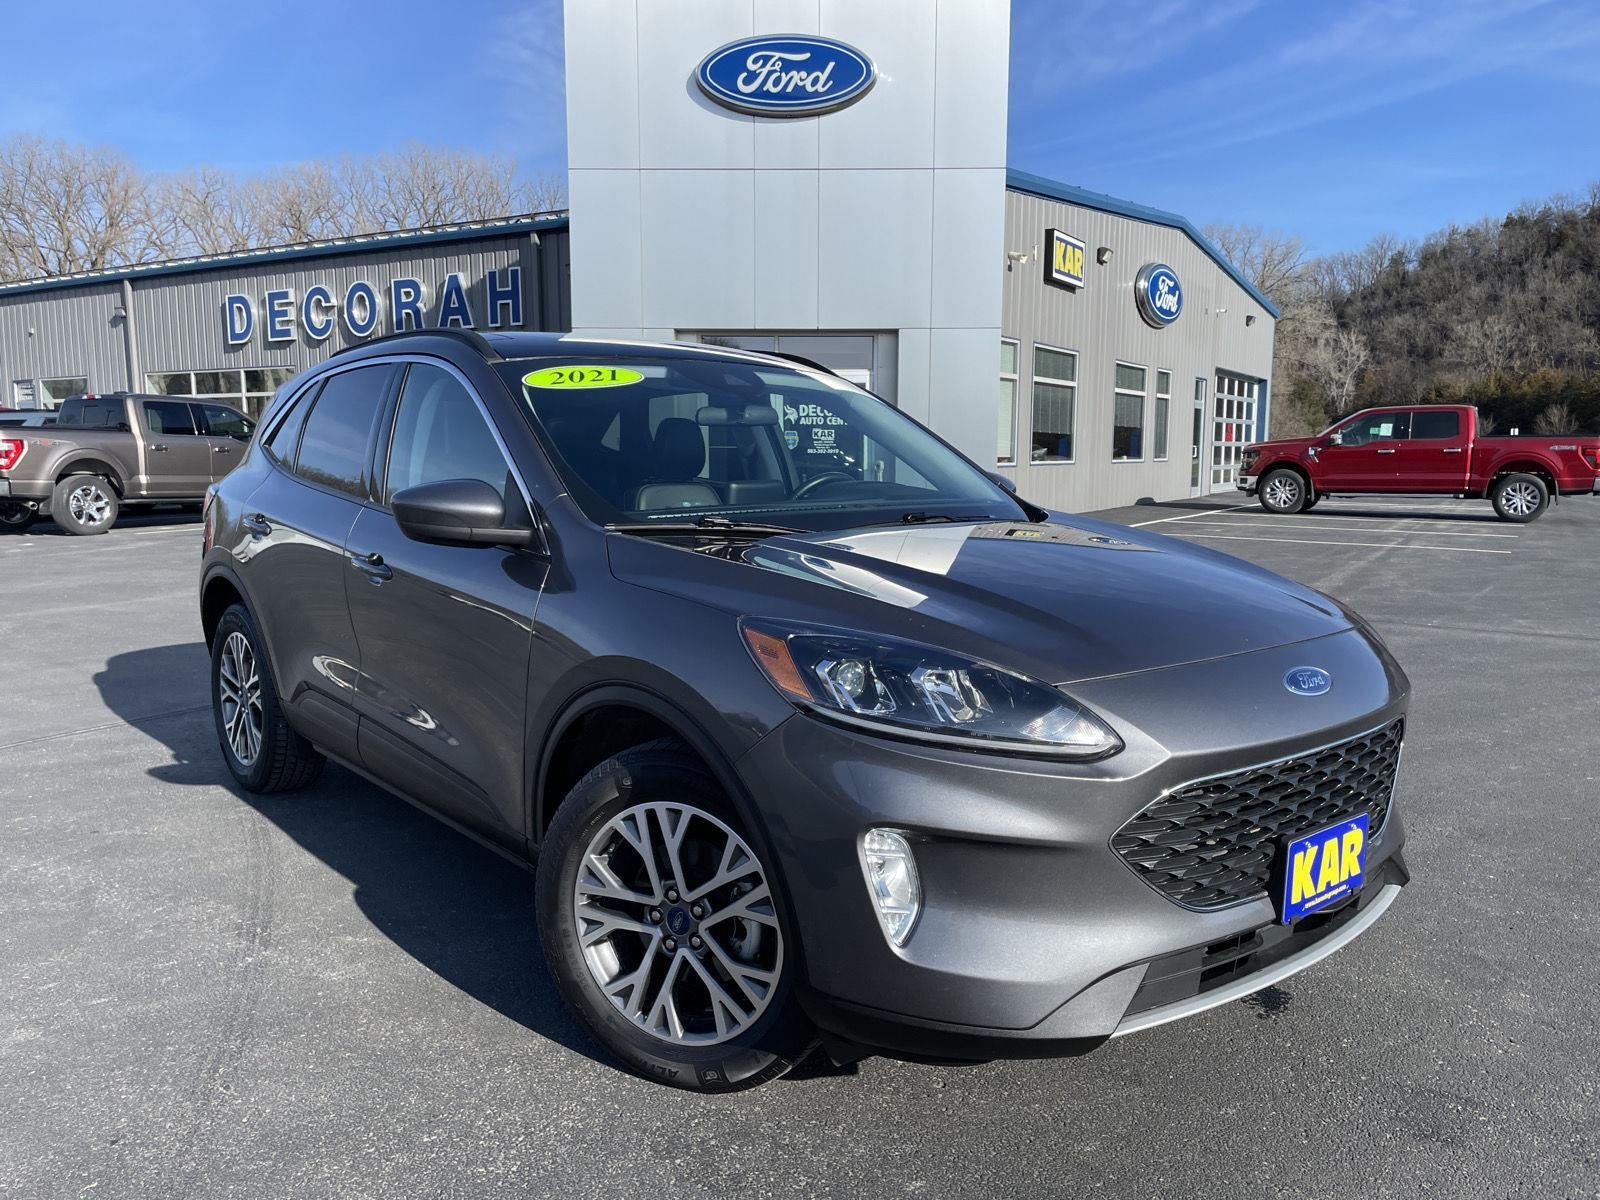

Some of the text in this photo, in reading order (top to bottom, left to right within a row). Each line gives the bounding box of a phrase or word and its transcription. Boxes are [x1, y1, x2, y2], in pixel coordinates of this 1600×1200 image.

[737, 51, 836, 93] Ford
[1055, 241, 1083, 277] KAR
[226, 267, 522, 344] DECORAH
[1155, 276, 1179, 313] Ford
[549, 369, 617, 385] 2021
[799, 417, 848, 425] AUTO CEN
[813, 430, 834, 438] KAR
[1297, 671, 1325, 689] Ford
[1291, 828, 1364, 905] KAR
